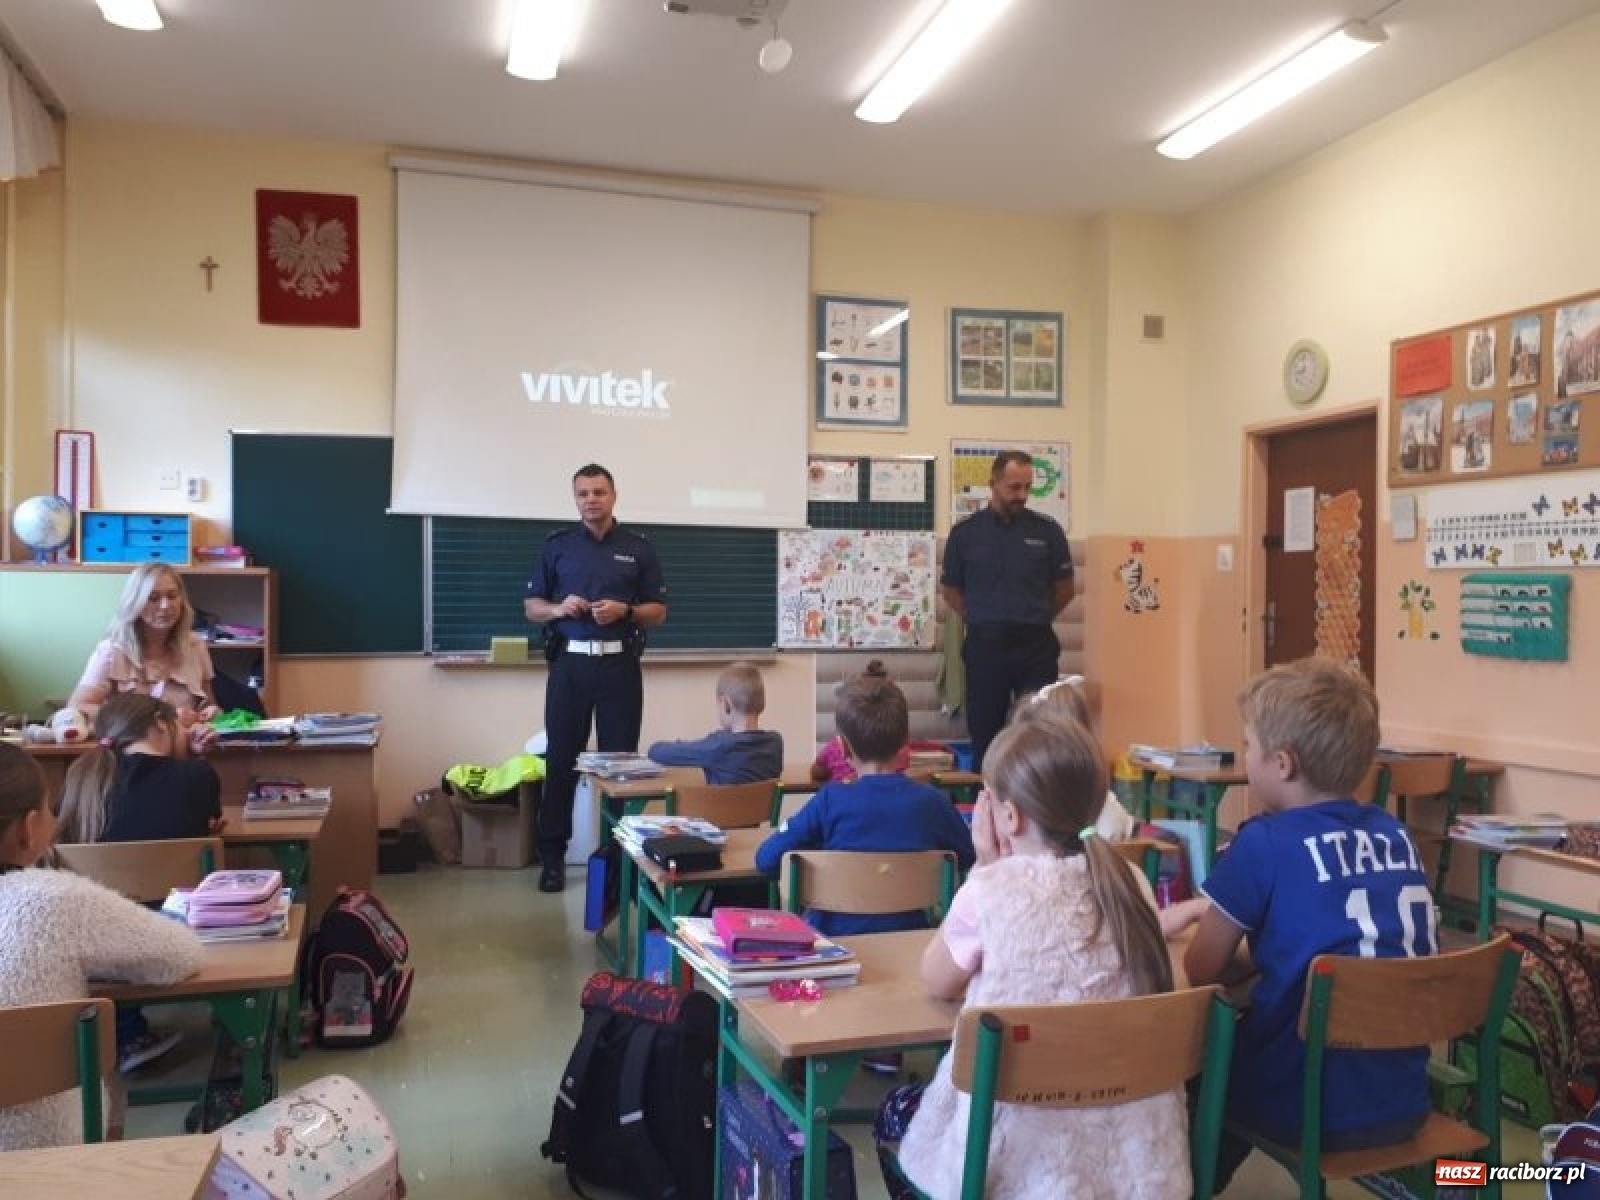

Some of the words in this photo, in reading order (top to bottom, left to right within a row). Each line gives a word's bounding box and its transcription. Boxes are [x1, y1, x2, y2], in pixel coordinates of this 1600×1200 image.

[520, 368, 670, 408] vivitek
[1303, 828, 1425, 882] ITALI
[1345, 885, 1438, 957] 10
